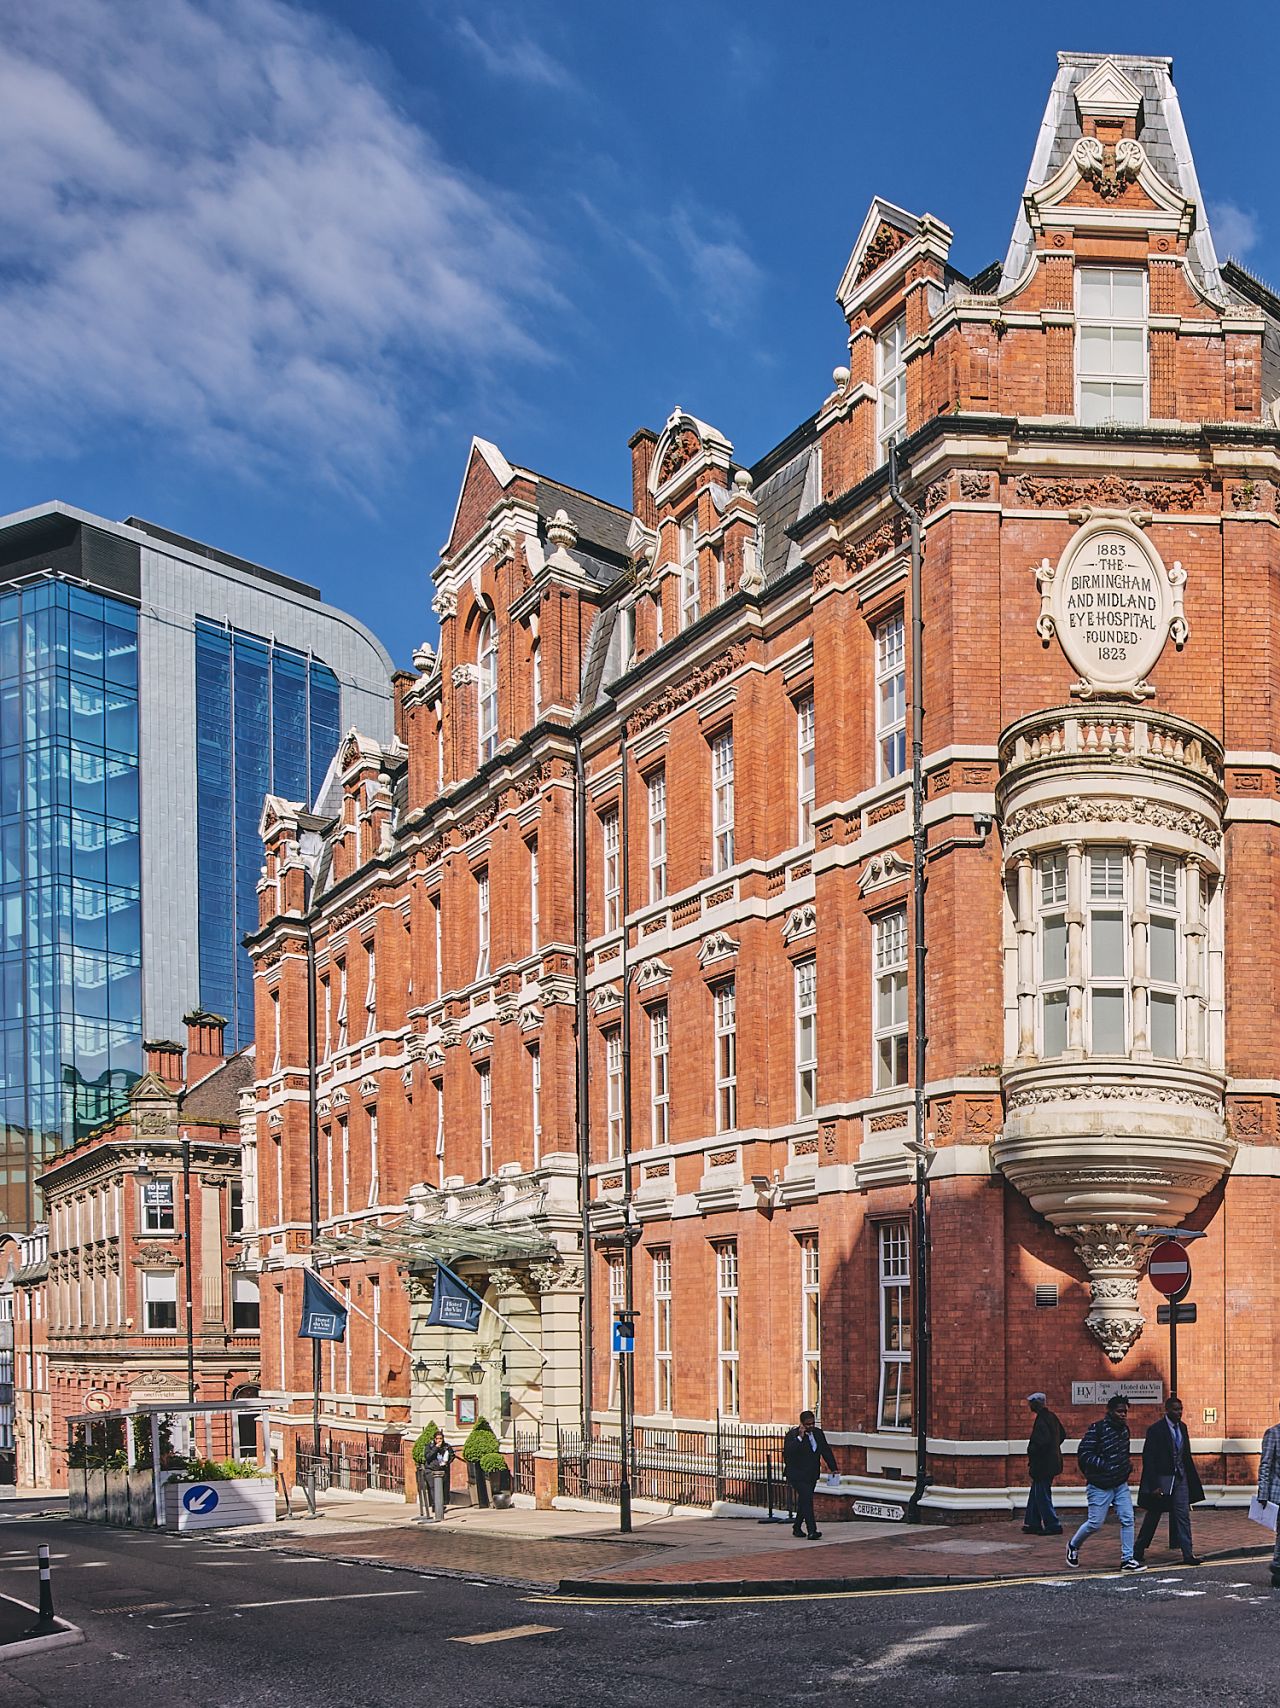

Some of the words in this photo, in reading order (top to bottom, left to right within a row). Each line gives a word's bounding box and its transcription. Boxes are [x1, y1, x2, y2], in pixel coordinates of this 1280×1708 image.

[1097, 544, 1126, 556] 1883
[1099, 558, 1124, 570] THE
[1071, 574, 1151, 592] BIRMINGHAM
[1068, 594, 1094, 609] AND
[1097, 593, 1156, 611] MIDLAND
[1070, 612, 1094, 628] EYE
[1096, 612, 1156, 630] HOSPITAL
[1086, 631, 1138, 644] FOUNDED
[1098, 648, 1126, 660] 1823
[1205, 1409, 1215, 1421] H
[858, 1504, 882, 1515] CHURCH
[887, 1508, 895, 1518] ST
